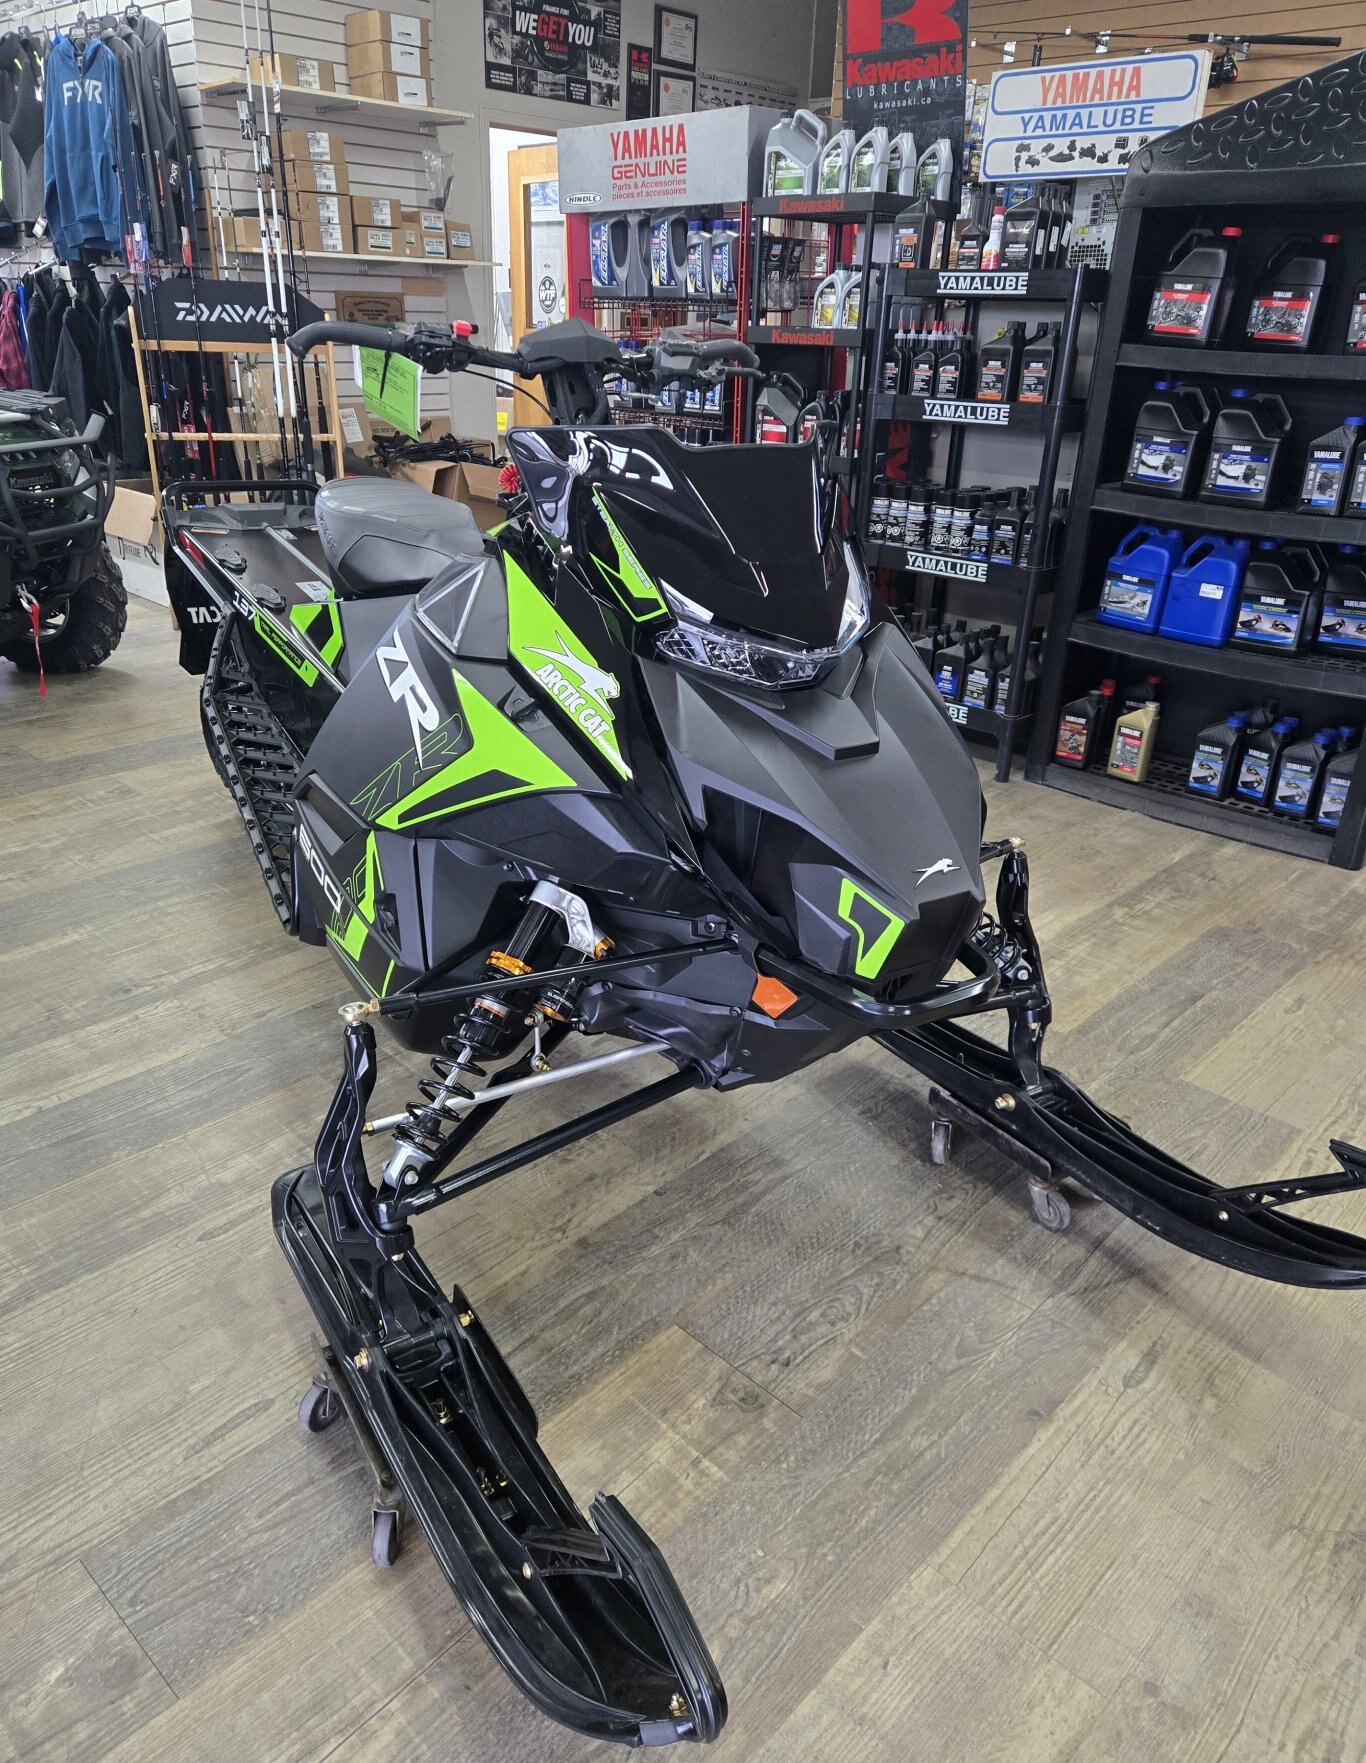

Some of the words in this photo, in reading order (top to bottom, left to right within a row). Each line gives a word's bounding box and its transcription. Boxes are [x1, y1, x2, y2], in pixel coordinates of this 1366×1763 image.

[846, 44, 963, 87] Kawasaki
[846, 74, 962, 99] LUBRICANTS
[1040, 66, 1142, 106] YAMAHA
[873, 96, 932, 109] kawasaki.ca
[1020, 105, 1155, 133] YAMALUBE
[609, 123, 687, 161] YAMAHA
[169, 163, 178, 185] FXR
[611, 157, 687, 180] GENUINE
[612, 182, 632, 191] Parts
[633, 181, 639, 190] &
[640, 176, 687, 189] Accessories
[636, 189, 644, 198] et
[645, 187, 687, 198] accessoires
[568, 195, 598, 203] HINDLE
[778, 195, 845, 214] Kawasaki
[938, 275, 1029, 291] YAMALUBE
[771, 329, 834, 345] Kawasaki
[923, 402, 1010, 421] YAMALUBE
[1314, 451, 1342, 459] YAMALUBE
[592, 496, 625, 548] STEALTH
[622, 547, 653, 590] SERIES
[906, 554, 988, 580] YAMALUBE
[232, 590, 256, 621] 137
[1261, 595, 1287, 606] YAMALUBE
[535, 662, 588, 715] ARCTIC
[578, 707, 612, 739] CAT
